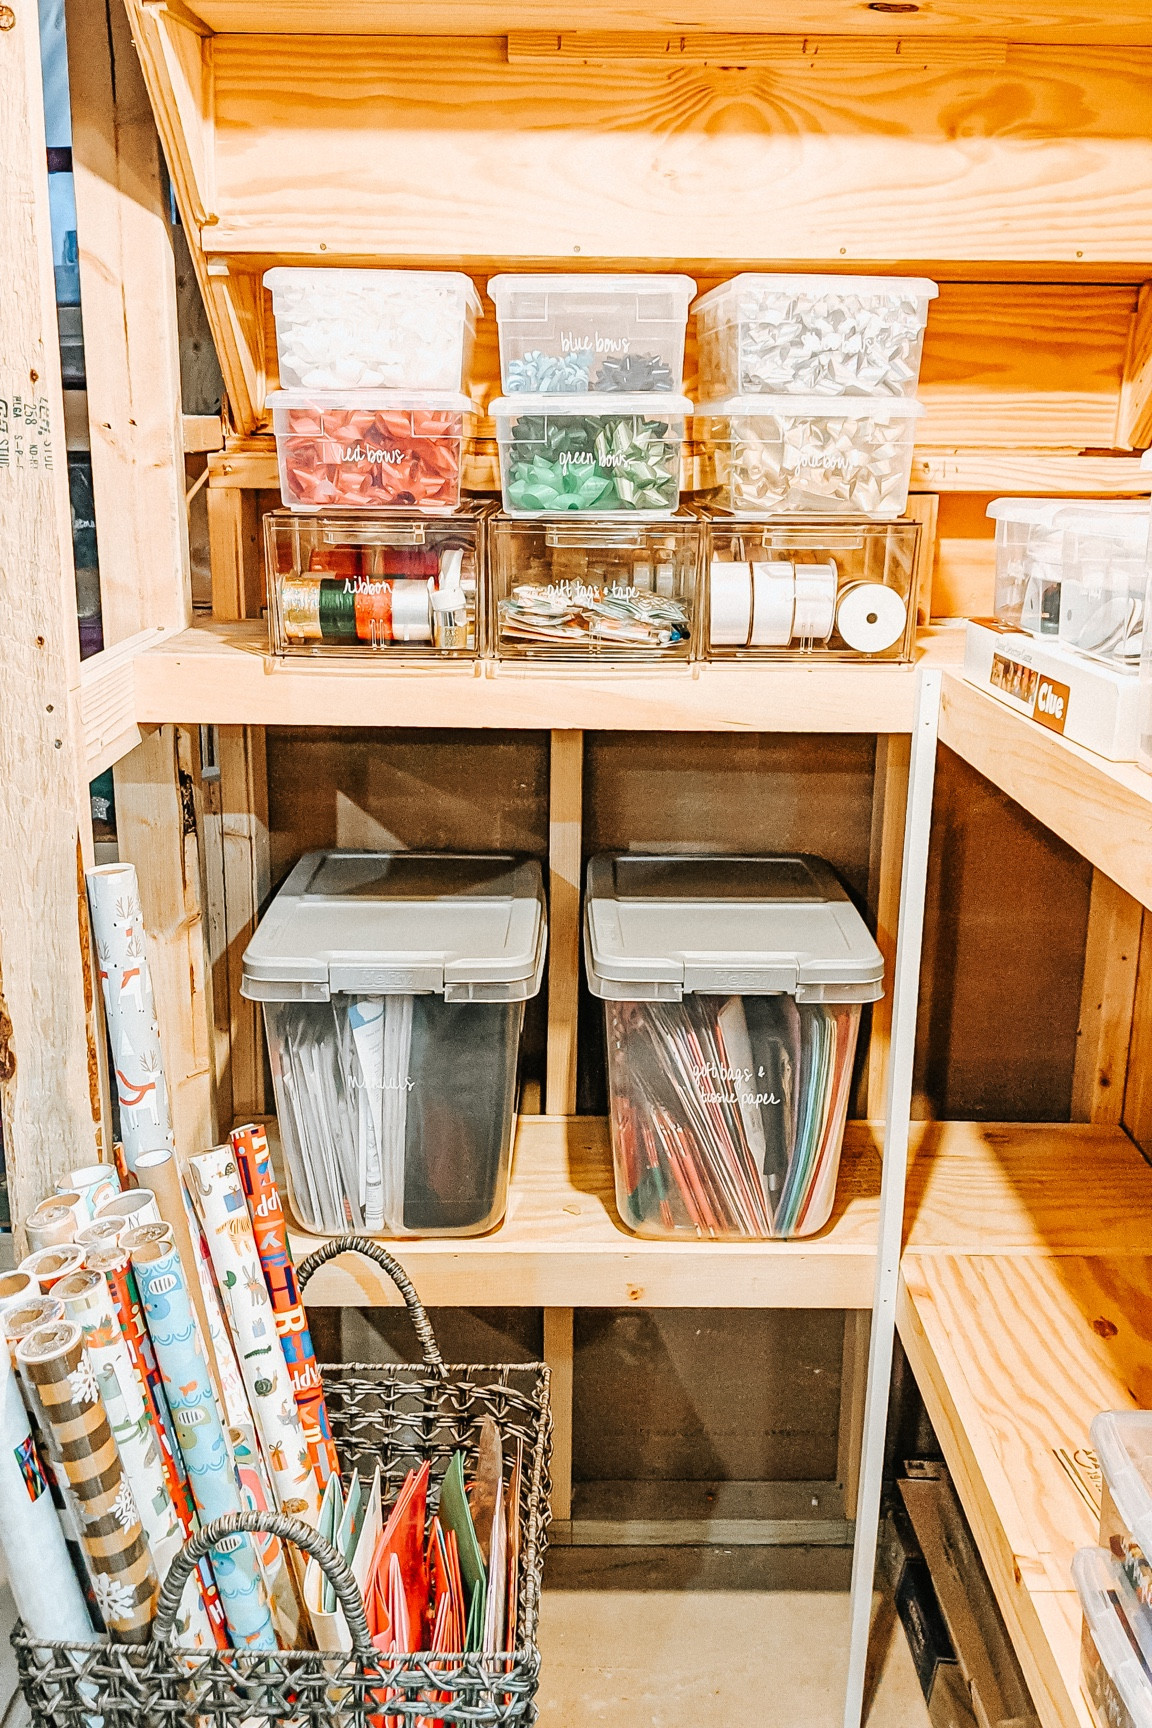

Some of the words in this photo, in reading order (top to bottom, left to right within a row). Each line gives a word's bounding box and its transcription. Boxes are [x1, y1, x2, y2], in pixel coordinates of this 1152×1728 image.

[560, 331, 593, 352] blue
[594, 330, 631, 353] bows
[23, 403, 38, 426] 258
[339, 444, 366, 462] red
[366, 443, 405, 464] bows
[559, 450, 597, 477] green
[598, 448, 629, 468] bows
[342, 575, 393, 596] ribbon
[575, 580, 601, 610] tags
[611, 579, 641, 604] tape
[1037, 682, 1065, 720] Clue
[692, 1061, 718, 1087] gift
[719, 1061, 753, 1092] bags
[700, 1085, 739, 1103] tissue
[739, 1092, 781, 1111] paper
